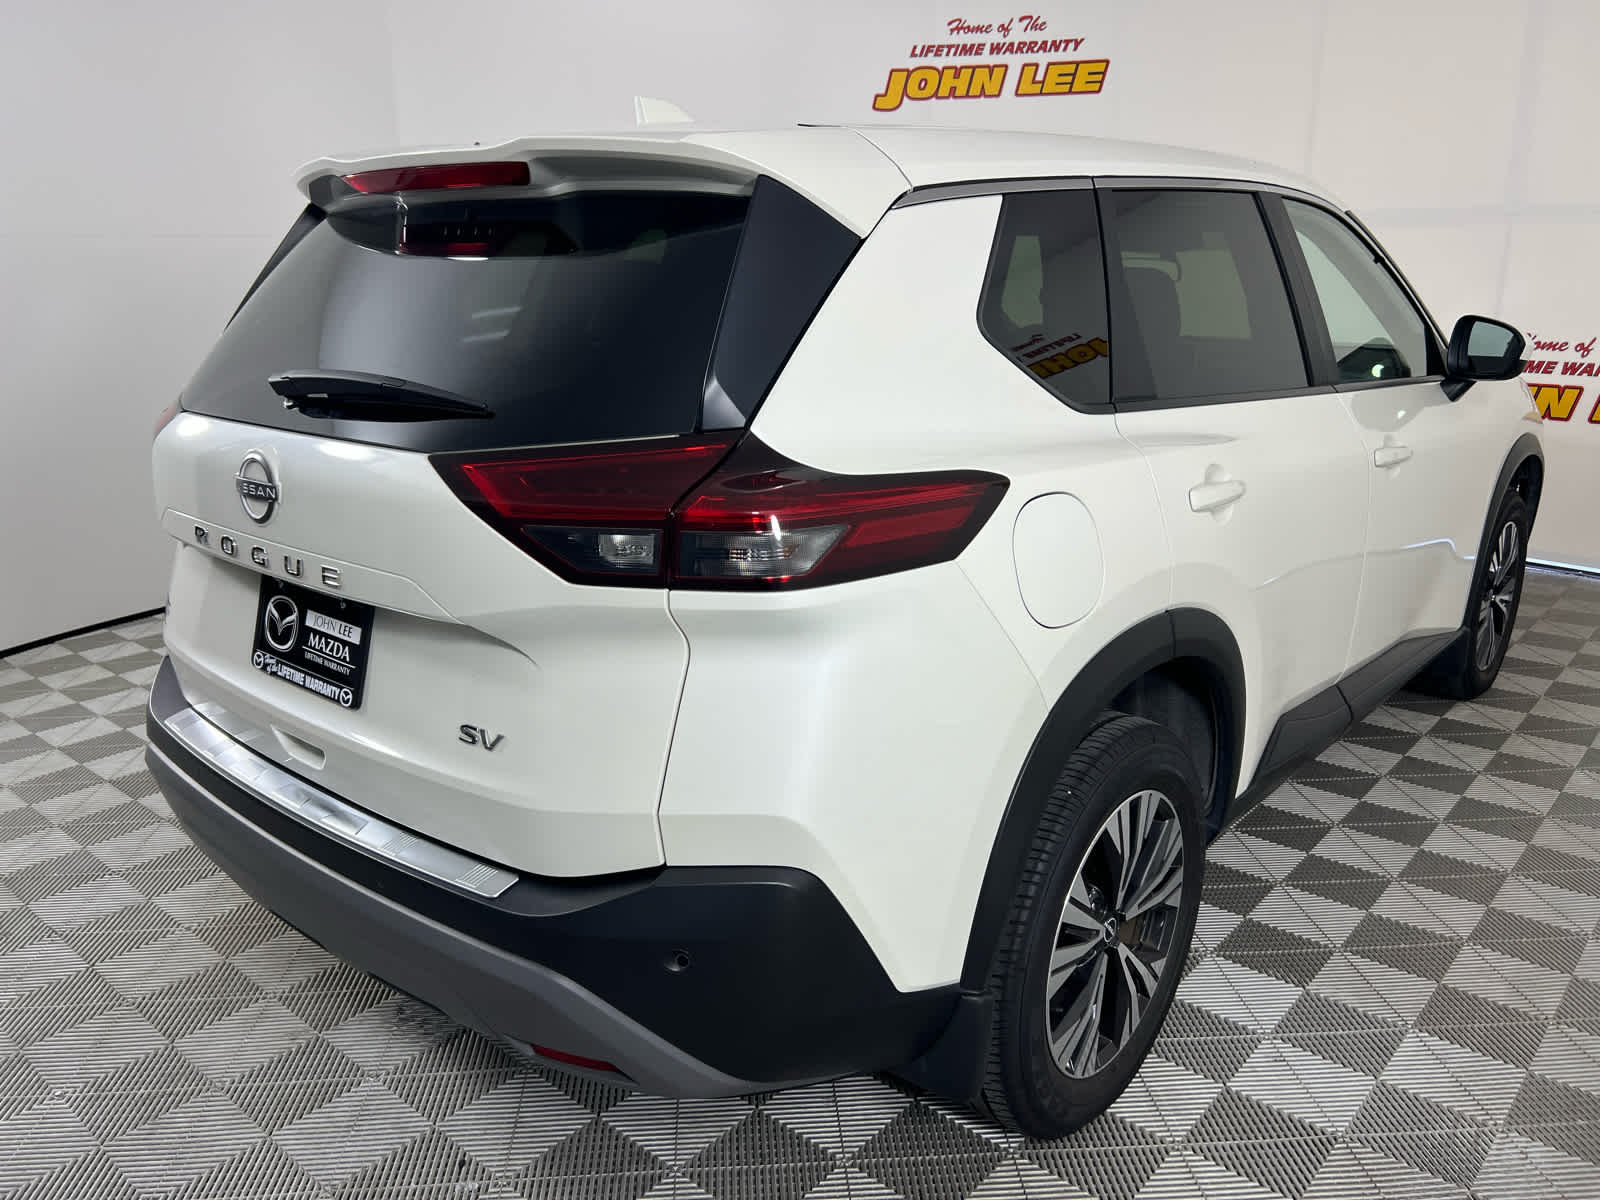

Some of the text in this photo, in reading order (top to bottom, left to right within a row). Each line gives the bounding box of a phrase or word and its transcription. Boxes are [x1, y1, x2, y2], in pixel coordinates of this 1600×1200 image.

[947, 15, 1048, 38] Home of The
[910, 37, 1085, 58] LIFETIME WARRANTY
[872, 59, 1111, 112] JOHN LEE
[1527, 332, 1597, 358] ome of
[194, 524, 342, 587] ROGUE
[312, 614, 354, 639] JOHN LEE
[308, 632, 350, 662] MAZDA
[277, 664, 305, 686] LIFETIME
[305, 674, 340, 701] WARRANTY
[458, 724, 505, 752] SV
